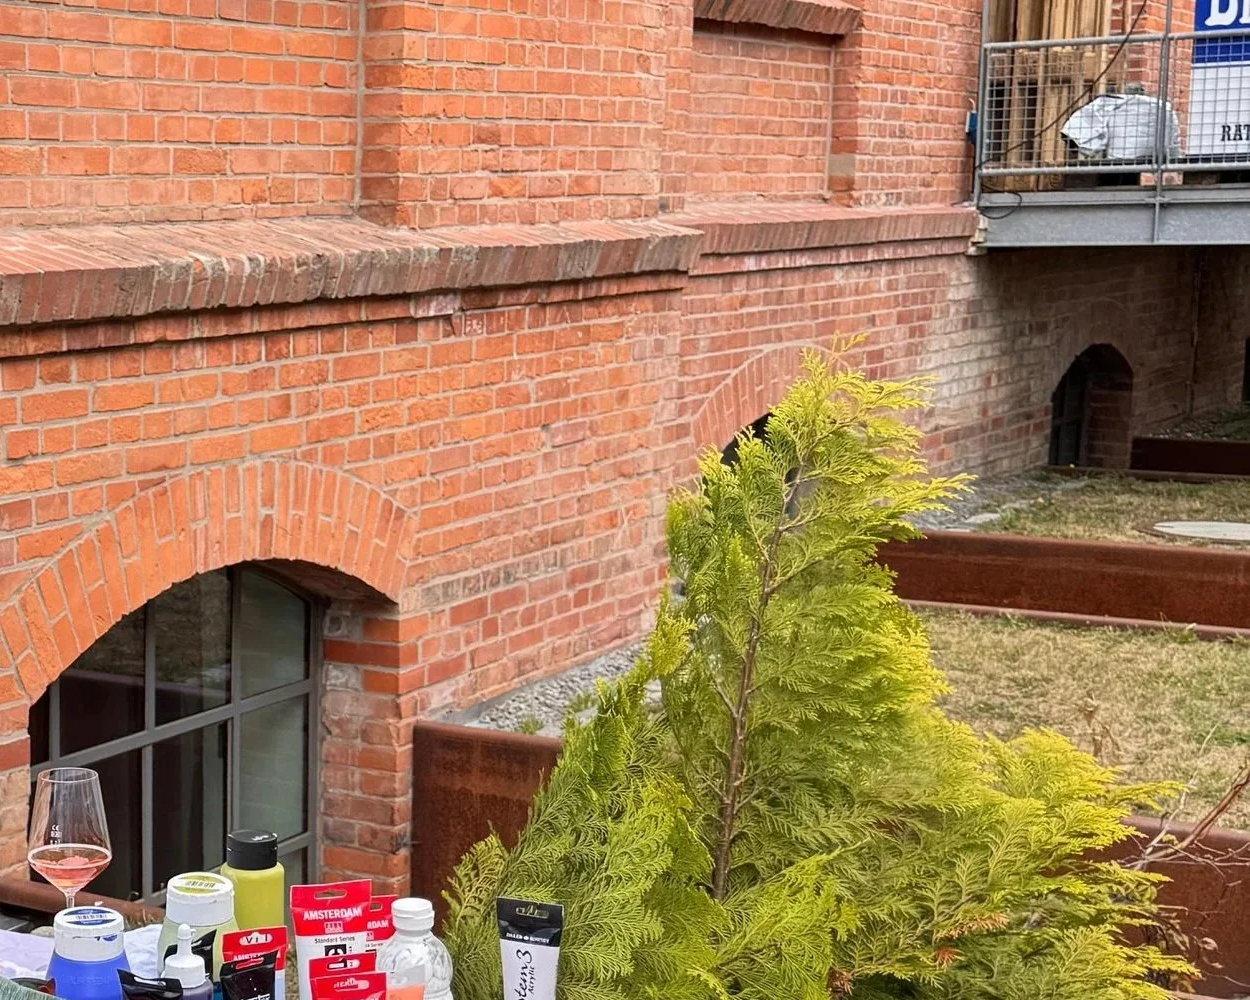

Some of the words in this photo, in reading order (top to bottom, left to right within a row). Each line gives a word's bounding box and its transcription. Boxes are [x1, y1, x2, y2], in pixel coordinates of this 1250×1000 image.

[303, 906, 363, 921] AMSTERDAM
[314, 936, 338, 945] Standard
[339, 935, 356, 943] Series
